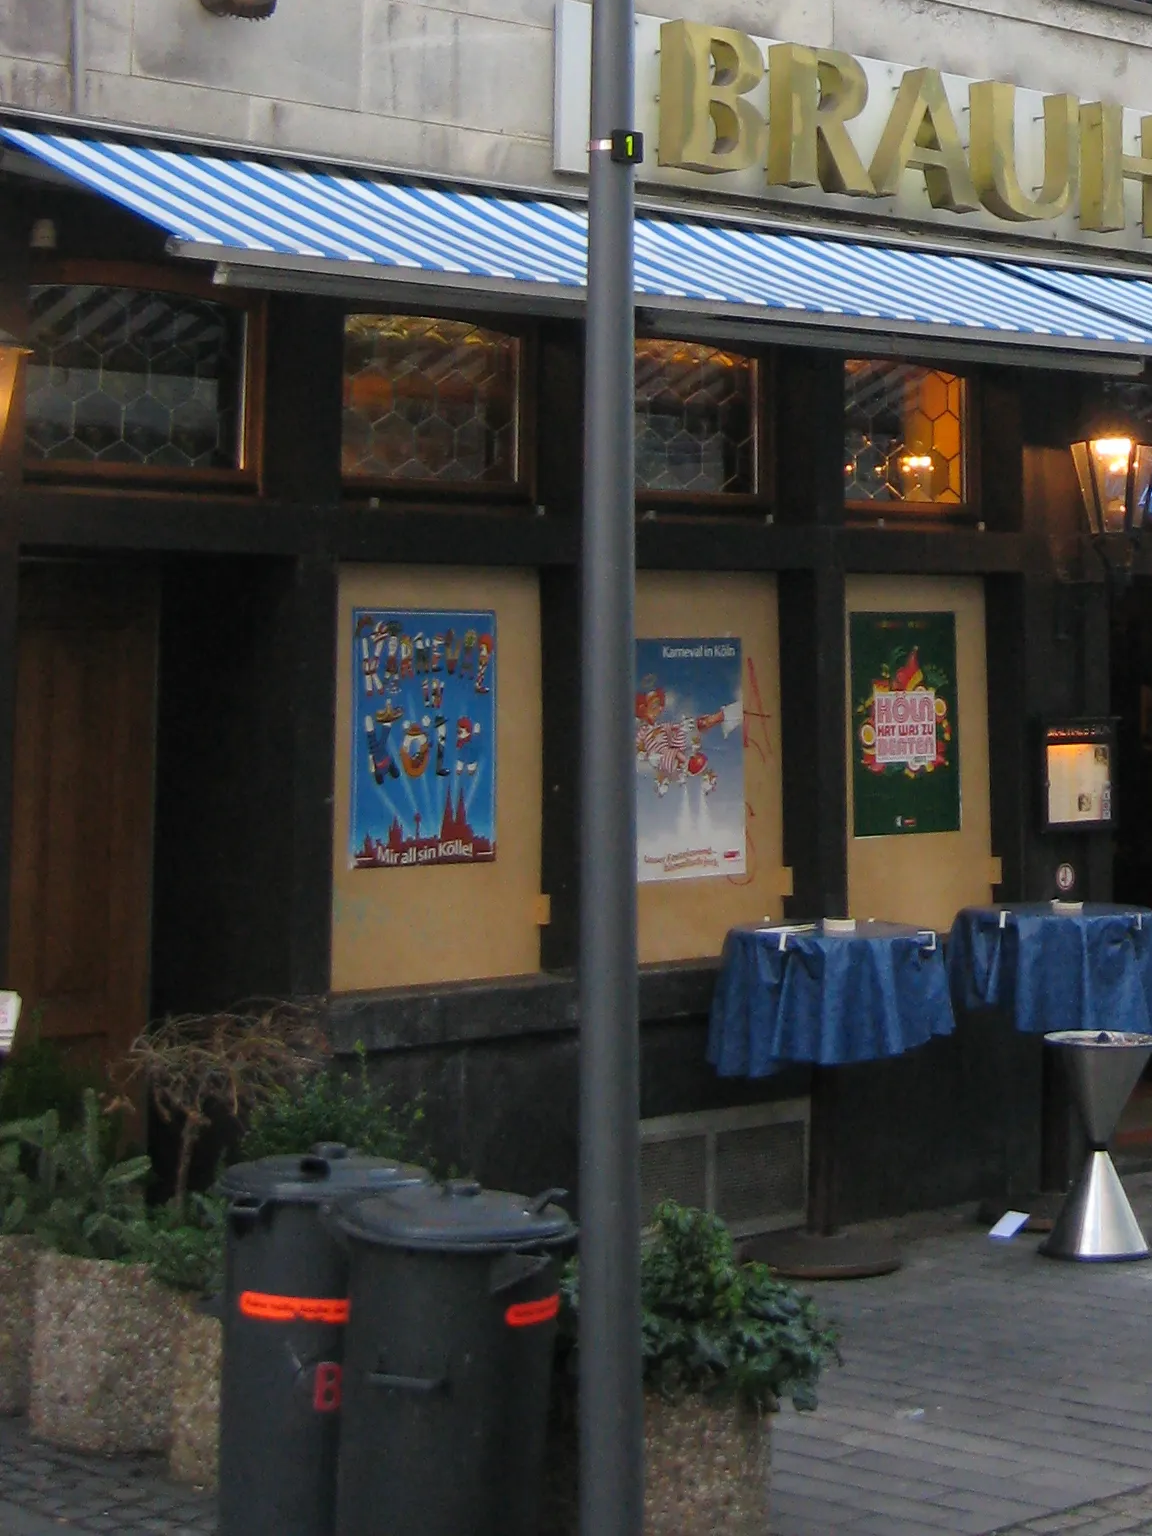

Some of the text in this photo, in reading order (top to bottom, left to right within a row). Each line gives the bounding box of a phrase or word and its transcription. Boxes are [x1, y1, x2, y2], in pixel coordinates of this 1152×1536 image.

[625, 135, 633, 157] 1
[662, 644, 736, 658] Karneval in Köln
[377, 845, 400, 864] Mir
[400, 846, 417, 864] all
[418, 845, 437, 861] sin
